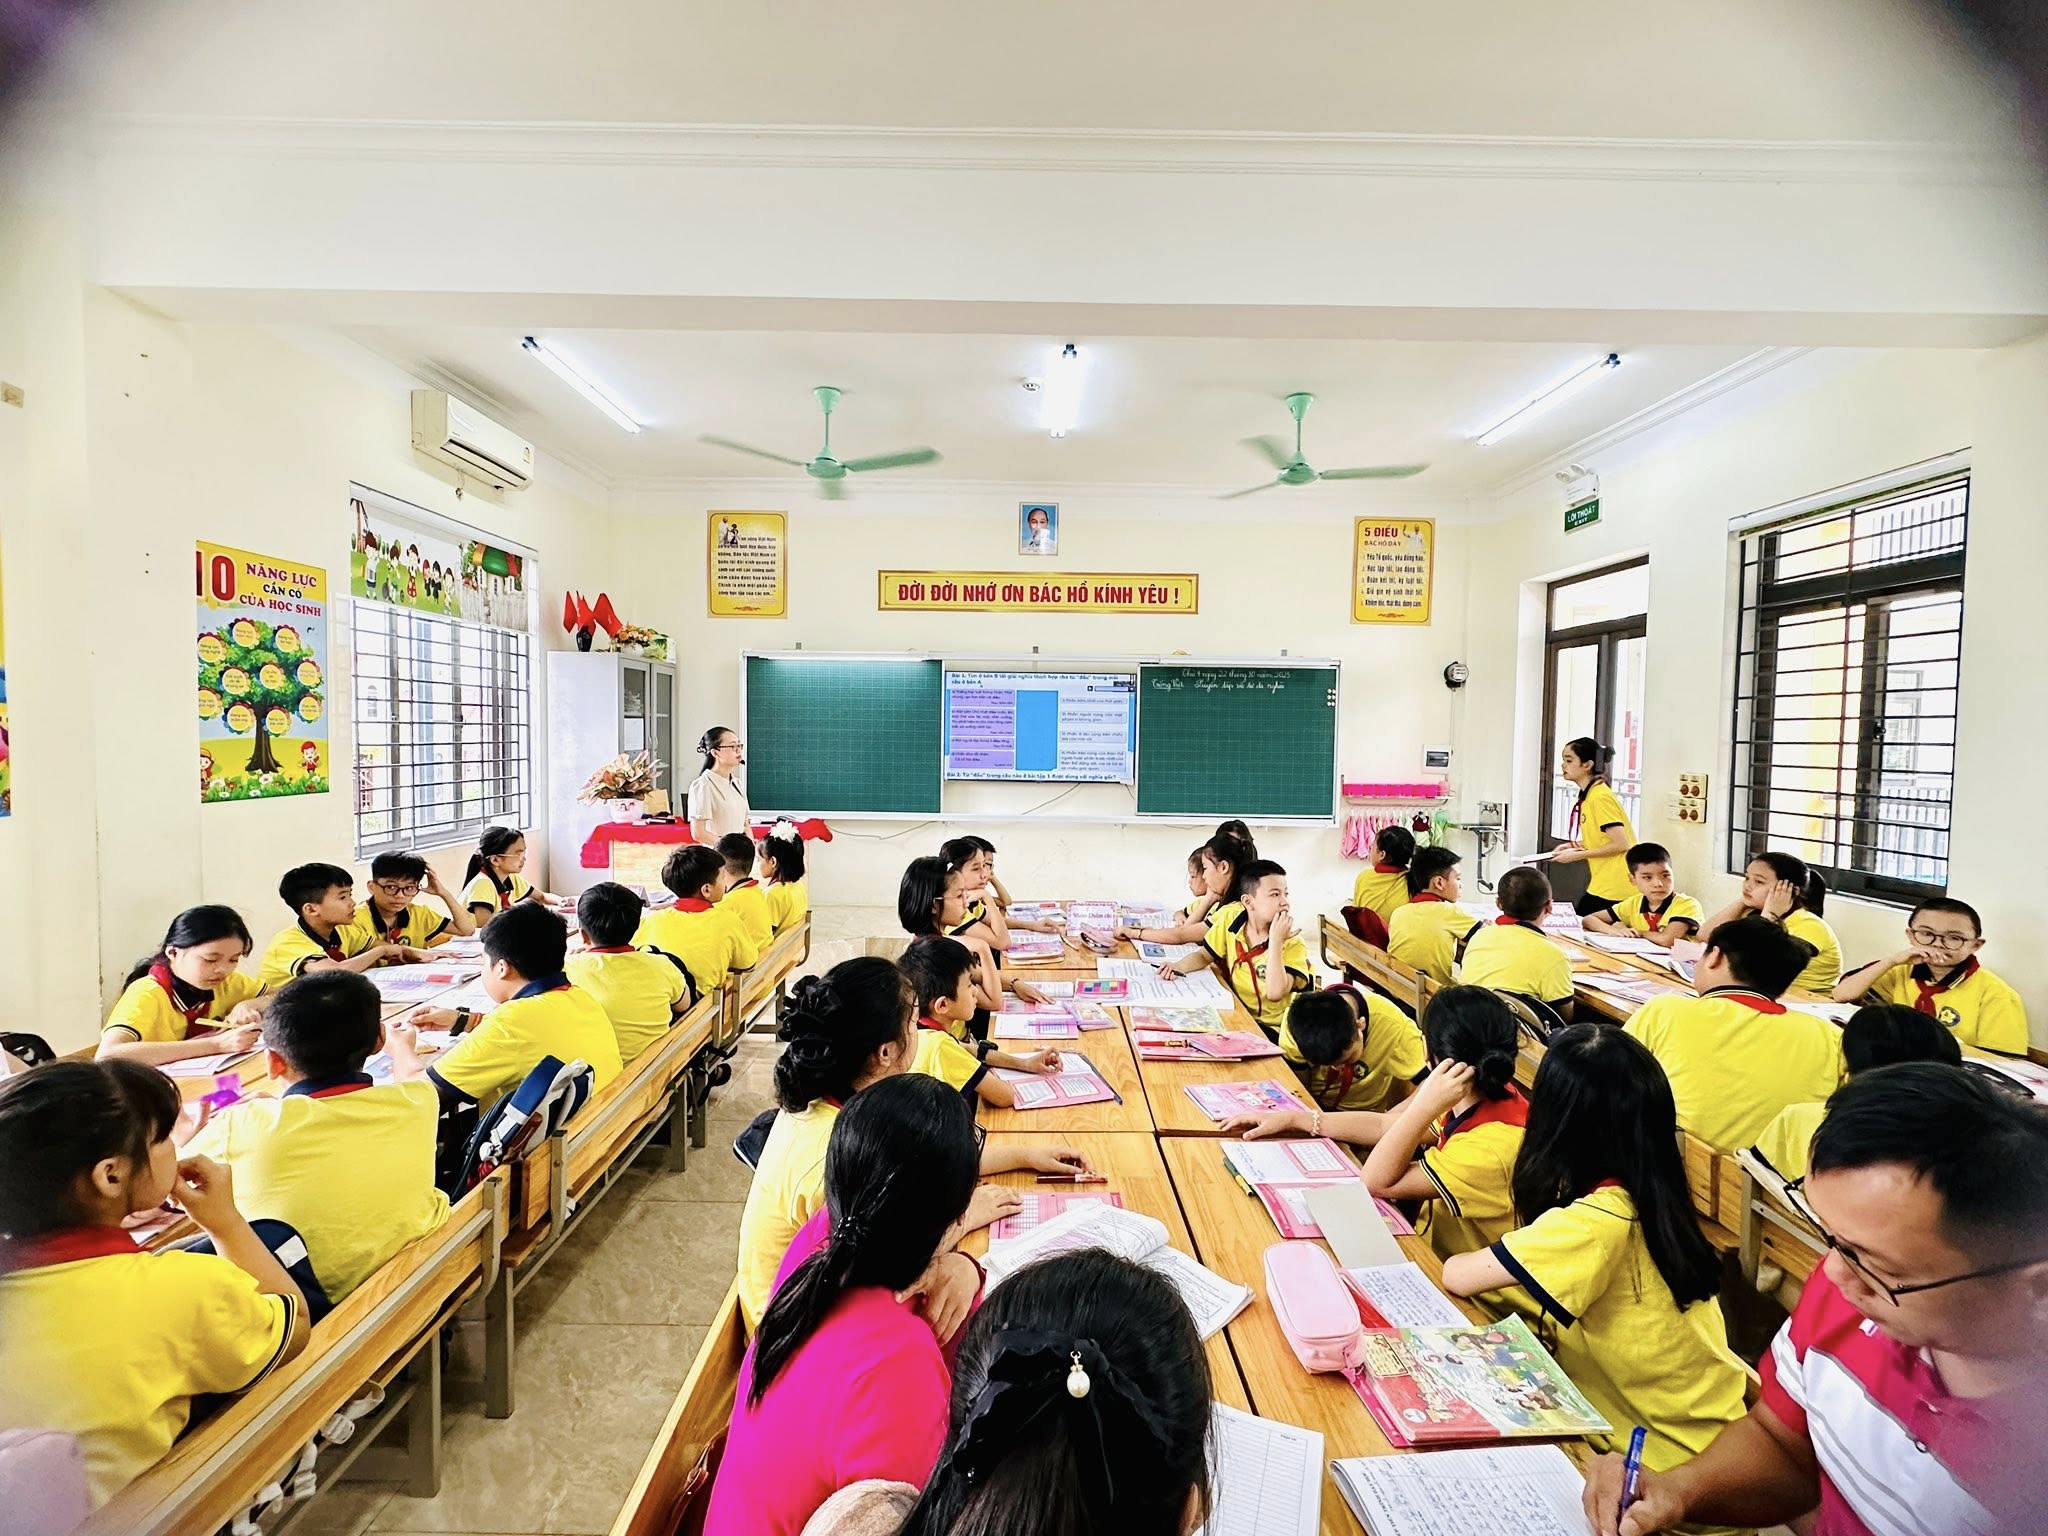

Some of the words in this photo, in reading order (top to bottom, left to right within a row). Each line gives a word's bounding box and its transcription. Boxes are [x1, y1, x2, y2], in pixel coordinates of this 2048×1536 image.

[1365, 527, 1370, 536] 5
[196, 551, 235, 601] 10
[246, 562, 288, 582] NĂNG
[292, 572, 318, 589] LỰC
[288, 588, 302, 599] CÓ
[898, 580, 926, 601] ĐỜI
[930, 580, 958, 602] ĐỜI
[963, 581, 997, 602] NHỚ
[1002, 583, 1024, 603] ƠN
[1029, 583, 1062, 603] BÁC
[1067, 581, 1089, 604] HỒ
[1094, 582, 1133, 604] KÍNH
[1138, 583, 1168, 604] YÊU
[1174, 586, 1179, 604] !
[240, 592, 265, 608] CỦA
[269, 599, 293, 613] HỌC
[296, 604, 321, 617] SINH
